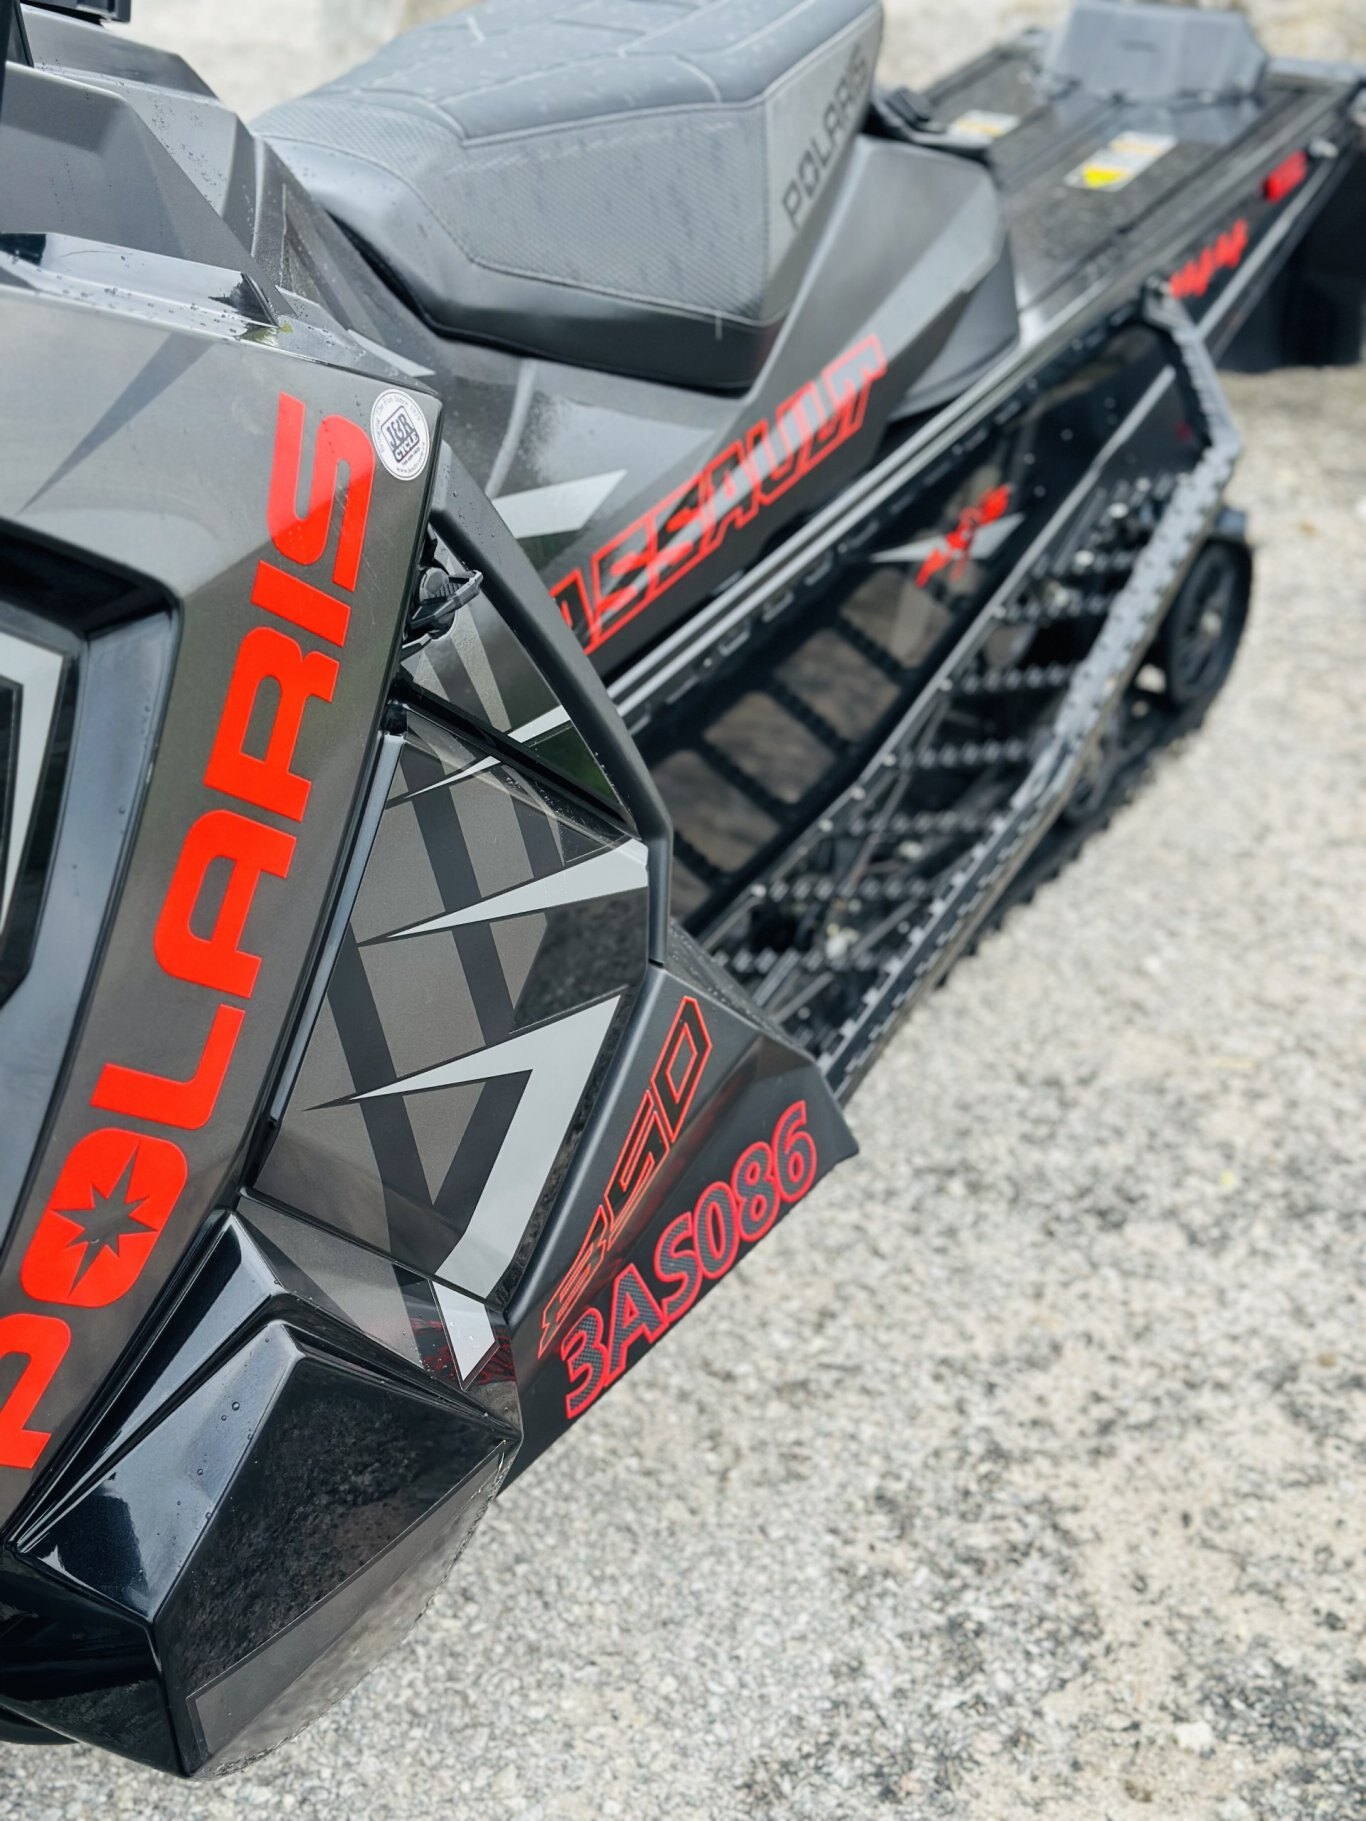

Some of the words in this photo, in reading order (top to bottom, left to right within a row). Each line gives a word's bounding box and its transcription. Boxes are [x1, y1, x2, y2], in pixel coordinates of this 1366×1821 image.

[782, 43, 867, 232] POLARIS
[385, 412, 414, 449] J&R
[393, 430, 419, 461] CYCLE
[560, 1100, 817, 1419] 3AS086
